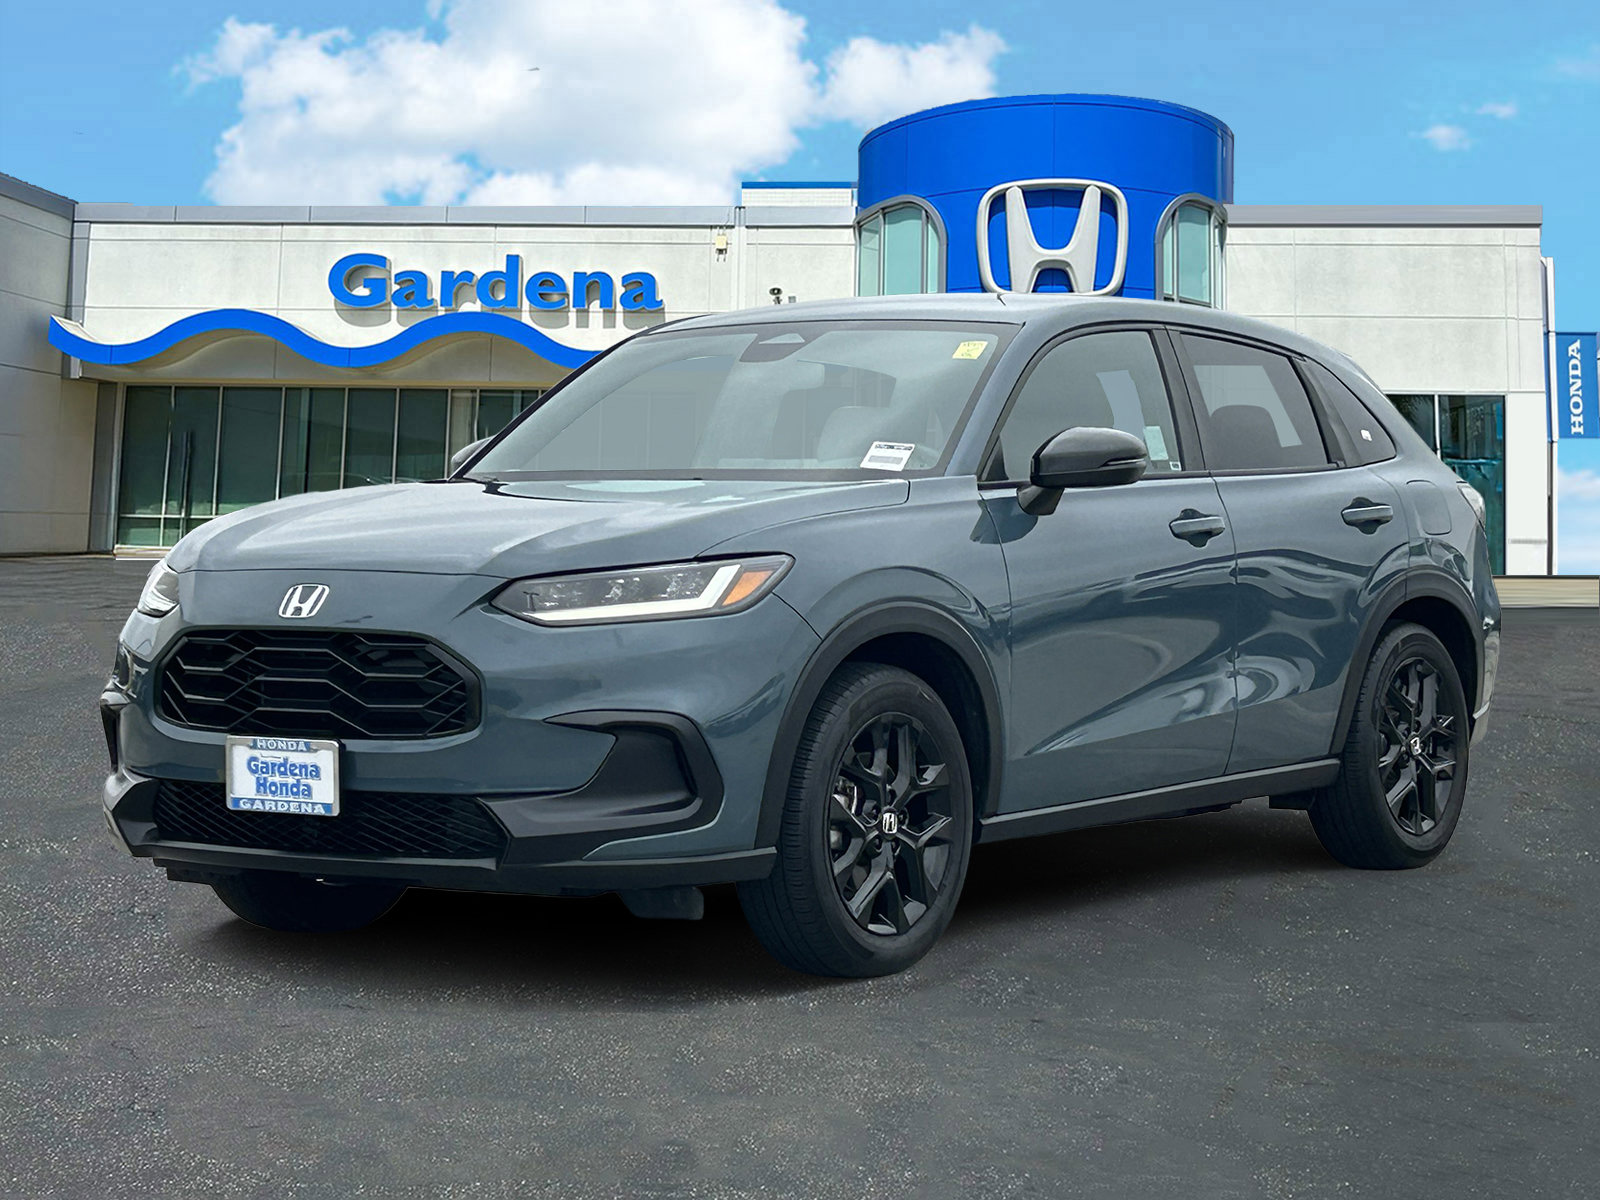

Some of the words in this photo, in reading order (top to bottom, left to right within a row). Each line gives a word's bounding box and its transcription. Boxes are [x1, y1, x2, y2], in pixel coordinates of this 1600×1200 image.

[328, 252, 664, 309] Gardena
[1568, 339, 1584, 435] HONDA
[256, 738, 307, 751] HONDA
[246, 756, 321, 779] Gardena
[255, 777, 312, 799] Honda
[239, 799, 326, 814] GARDENA
